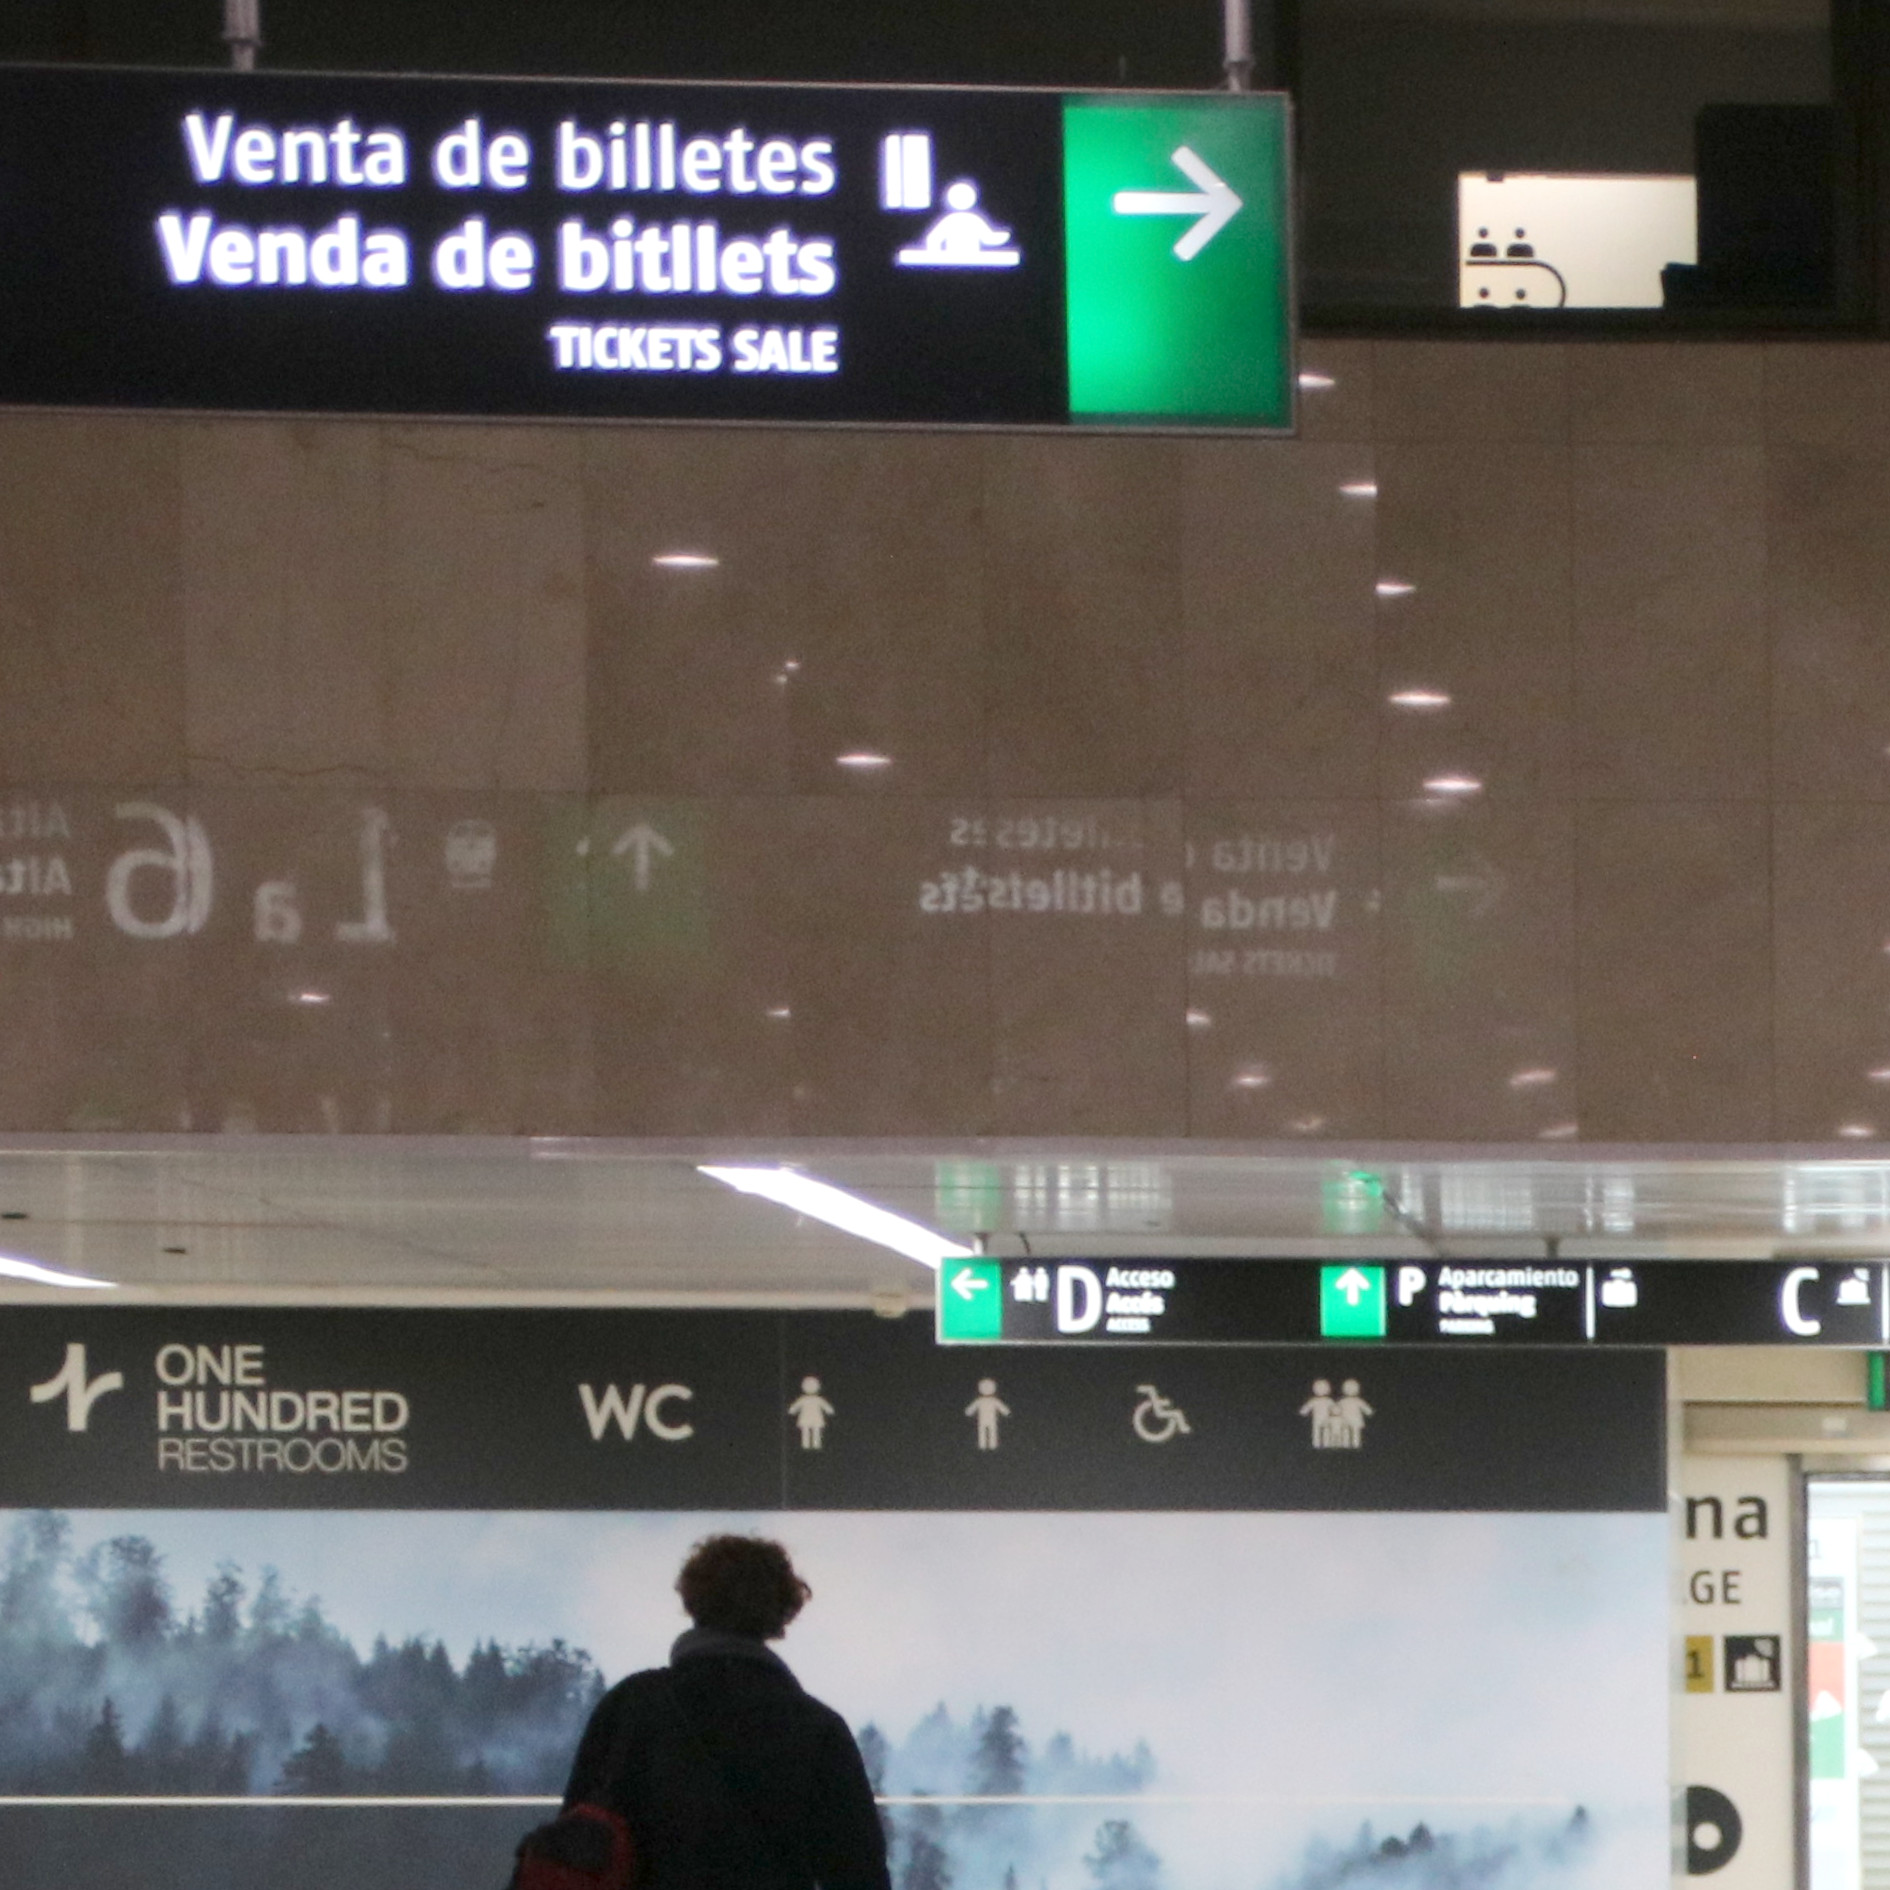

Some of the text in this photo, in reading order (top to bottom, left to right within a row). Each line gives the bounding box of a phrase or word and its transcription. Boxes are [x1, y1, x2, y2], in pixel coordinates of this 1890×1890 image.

[183, 111, 837, 200] Venta de billetes
[158, 213, 838, 298] Venda de bitllets
[549, 322, 840, 374] TICKETS SALE
[1056, 1265, 1103, 1334] D
[1106, 1266, 1176, 1289] Acceso
[1398, 1266, 1427, 1306] P
[1438, 1266, 1580, 1290] Aparcamiento
[1780, 1267, 1821, 1337] C
[155, 1344, 264, 1387] ONE
[157, 1391, 409, 1433] HUNDRED
[578, 1383, 695, 1441] WC
[158, 1438, 408, 1473] RESTROOMS
[1686, 1494, 1769, 1540] na
